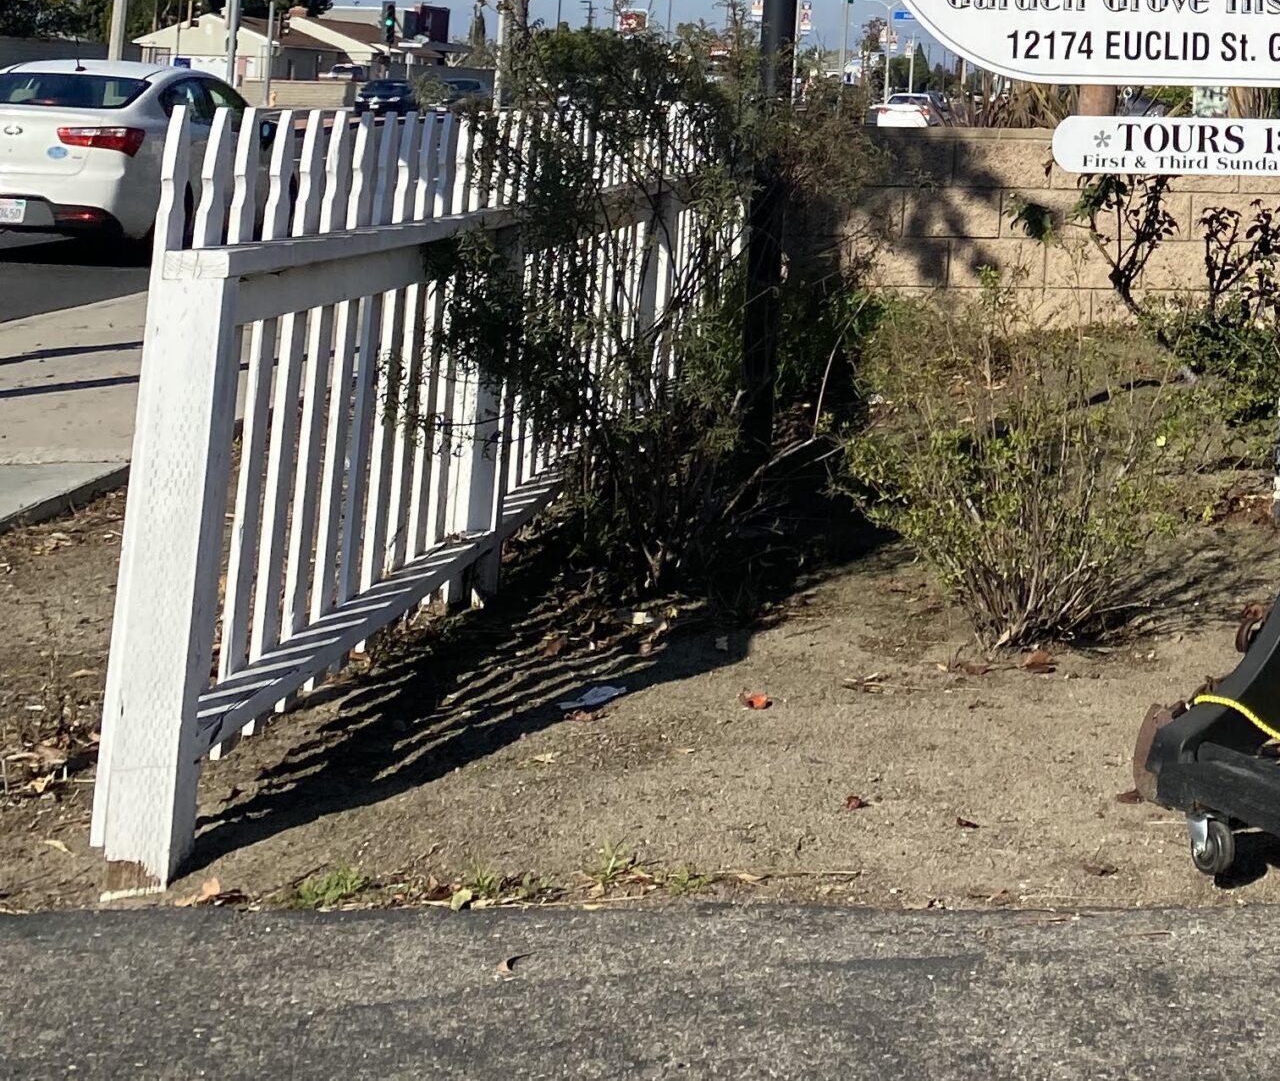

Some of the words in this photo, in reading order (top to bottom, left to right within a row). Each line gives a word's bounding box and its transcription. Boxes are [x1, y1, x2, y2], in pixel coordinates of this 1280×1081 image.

[1007, 31, 1094, 60] 12174
[1105, 31, 1210, 61] EUCLID
[1220, 32, 1256, 62] St.
[1117, 123, 1245, 154] TOURS
[1082, 154, 1126, 169] First
[1135, 155, 1147, 169] &
[1156, 155, 1208, 169] Third
